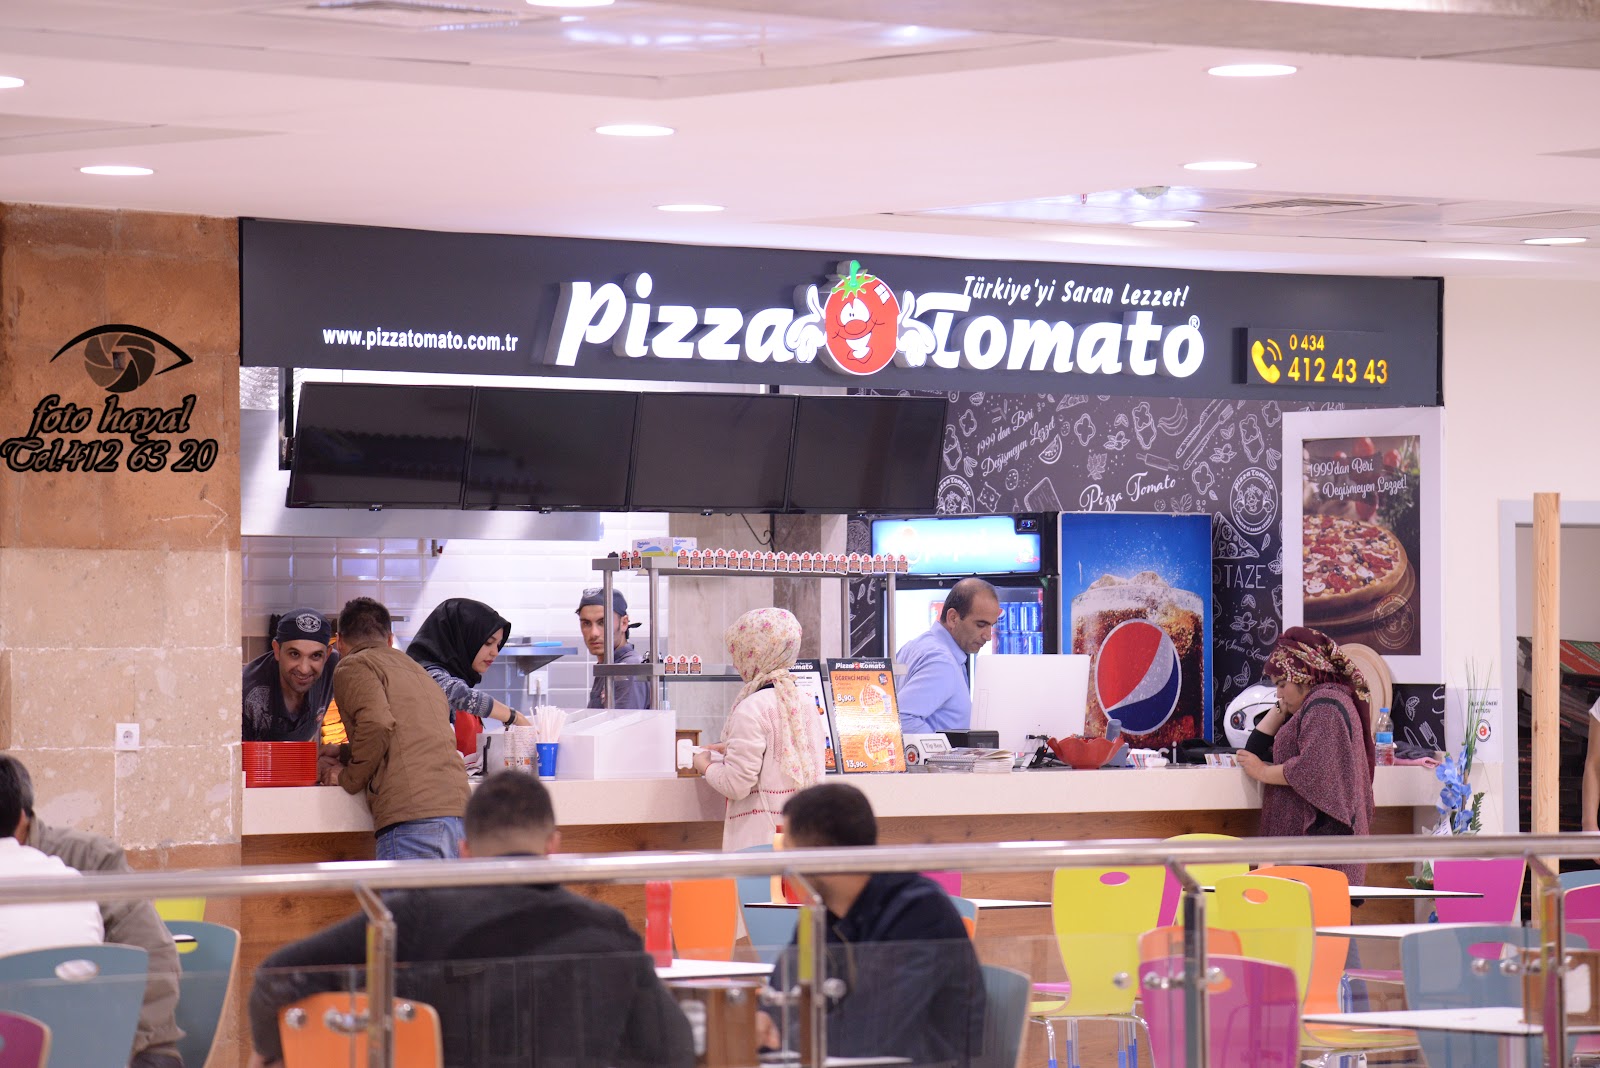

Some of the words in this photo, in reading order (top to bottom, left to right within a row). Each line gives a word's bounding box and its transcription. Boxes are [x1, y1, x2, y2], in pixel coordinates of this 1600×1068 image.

[963, 275, 1057, 307] Türkiye'yi
[1061, 279, 1114, 304] Saran
[1120, 283, 1190, 307] Lezzet!
[322, 326, 519, 352] www.pizzatomato.com.tr
[916, 291, 1205, 379] Tomato
[1289, 333, 1298, 351] 0
[1300, 334, 1325, 351] 434
[1287, 356, 1326, 382] 412
[1331, 358, 1358, 384] 43
[1363, 359, 1388, 385] 43
[976, 426, 1012, 456] 1999'dan
[1309, 460, 1350, 477] 1999'dan
[1351, 457, 1374, 474] Beri
[1079, 483, 1123, 512] Pizza
[1125, 471, 1176, 502] Tomato
[1377, 474, 1407, 496] Lezzet!
[1223, 564, 1266, 589] TAZE
